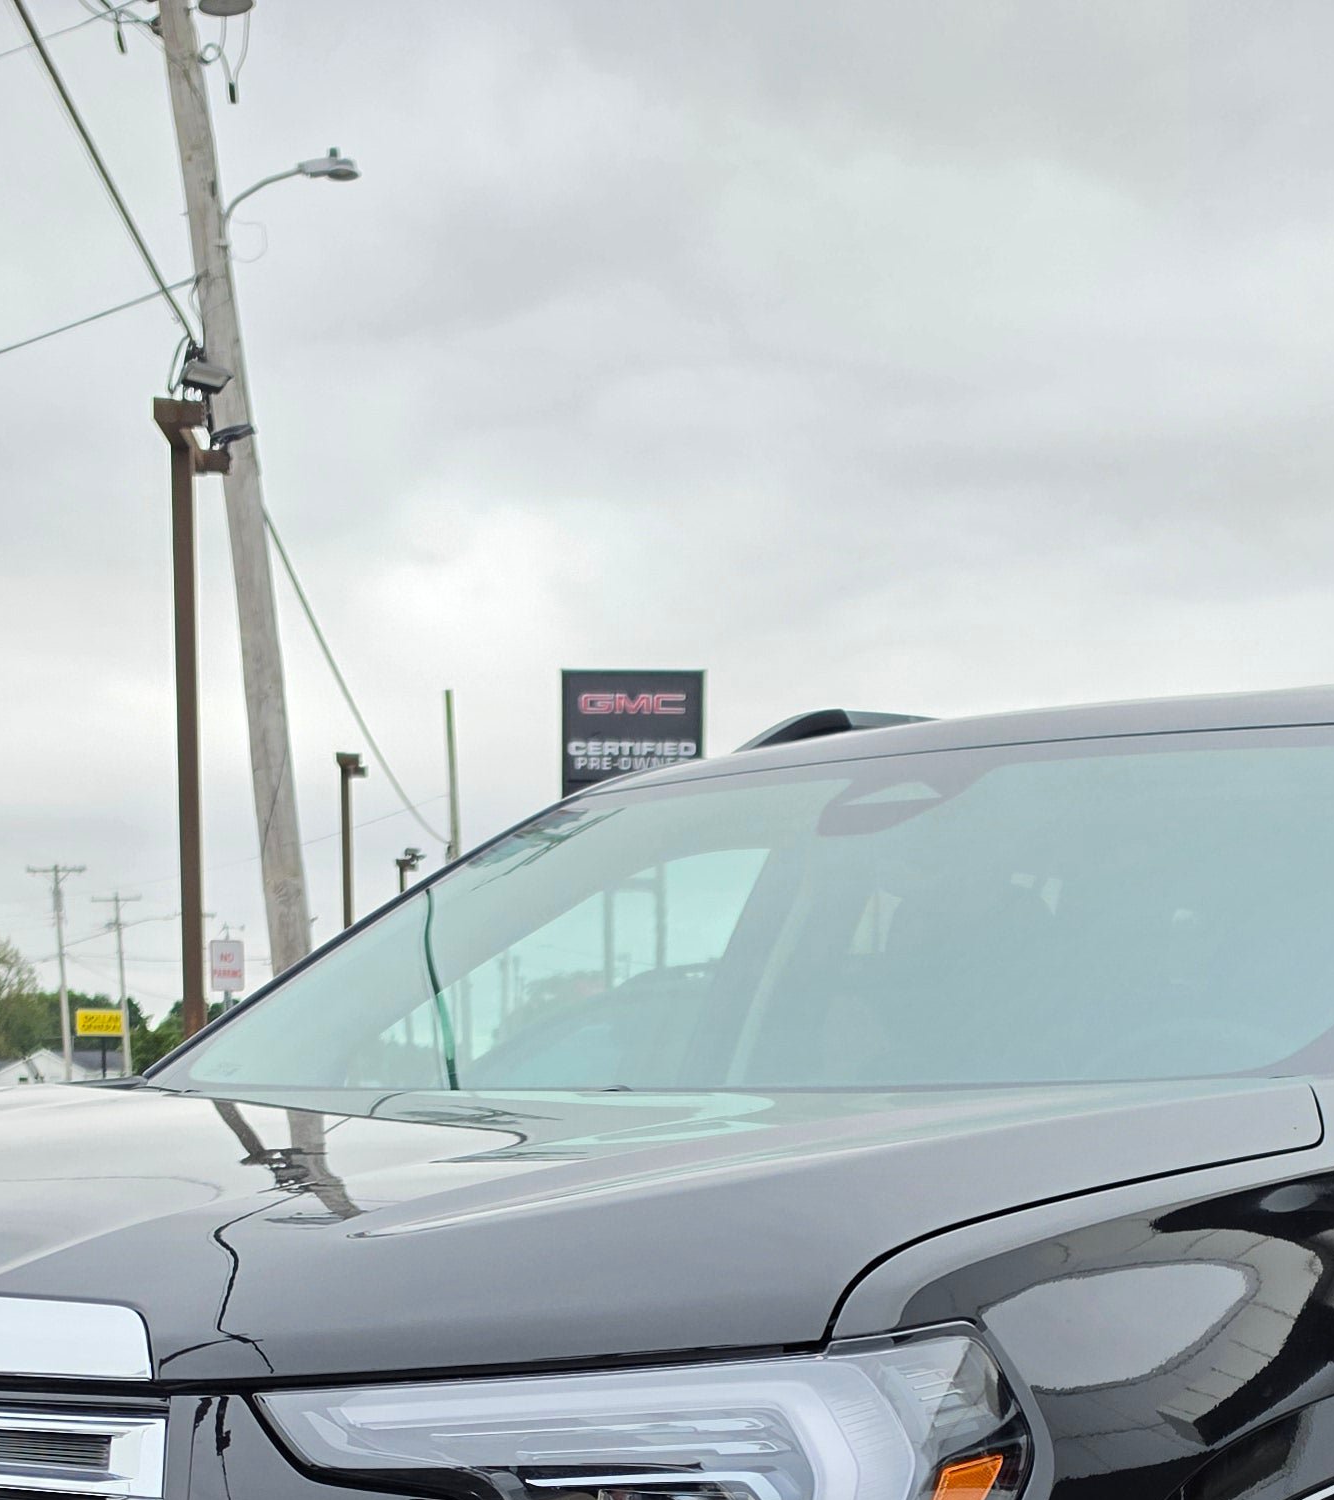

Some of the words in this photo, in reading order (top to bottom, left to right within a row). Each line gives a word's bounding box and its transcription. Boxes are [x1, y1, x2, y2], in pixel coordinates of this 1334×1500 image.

[578, 693, 687, 715] GMC
[567, 740, 697, 757] CERTIFIED
[219, 951, 235, 964] NO
